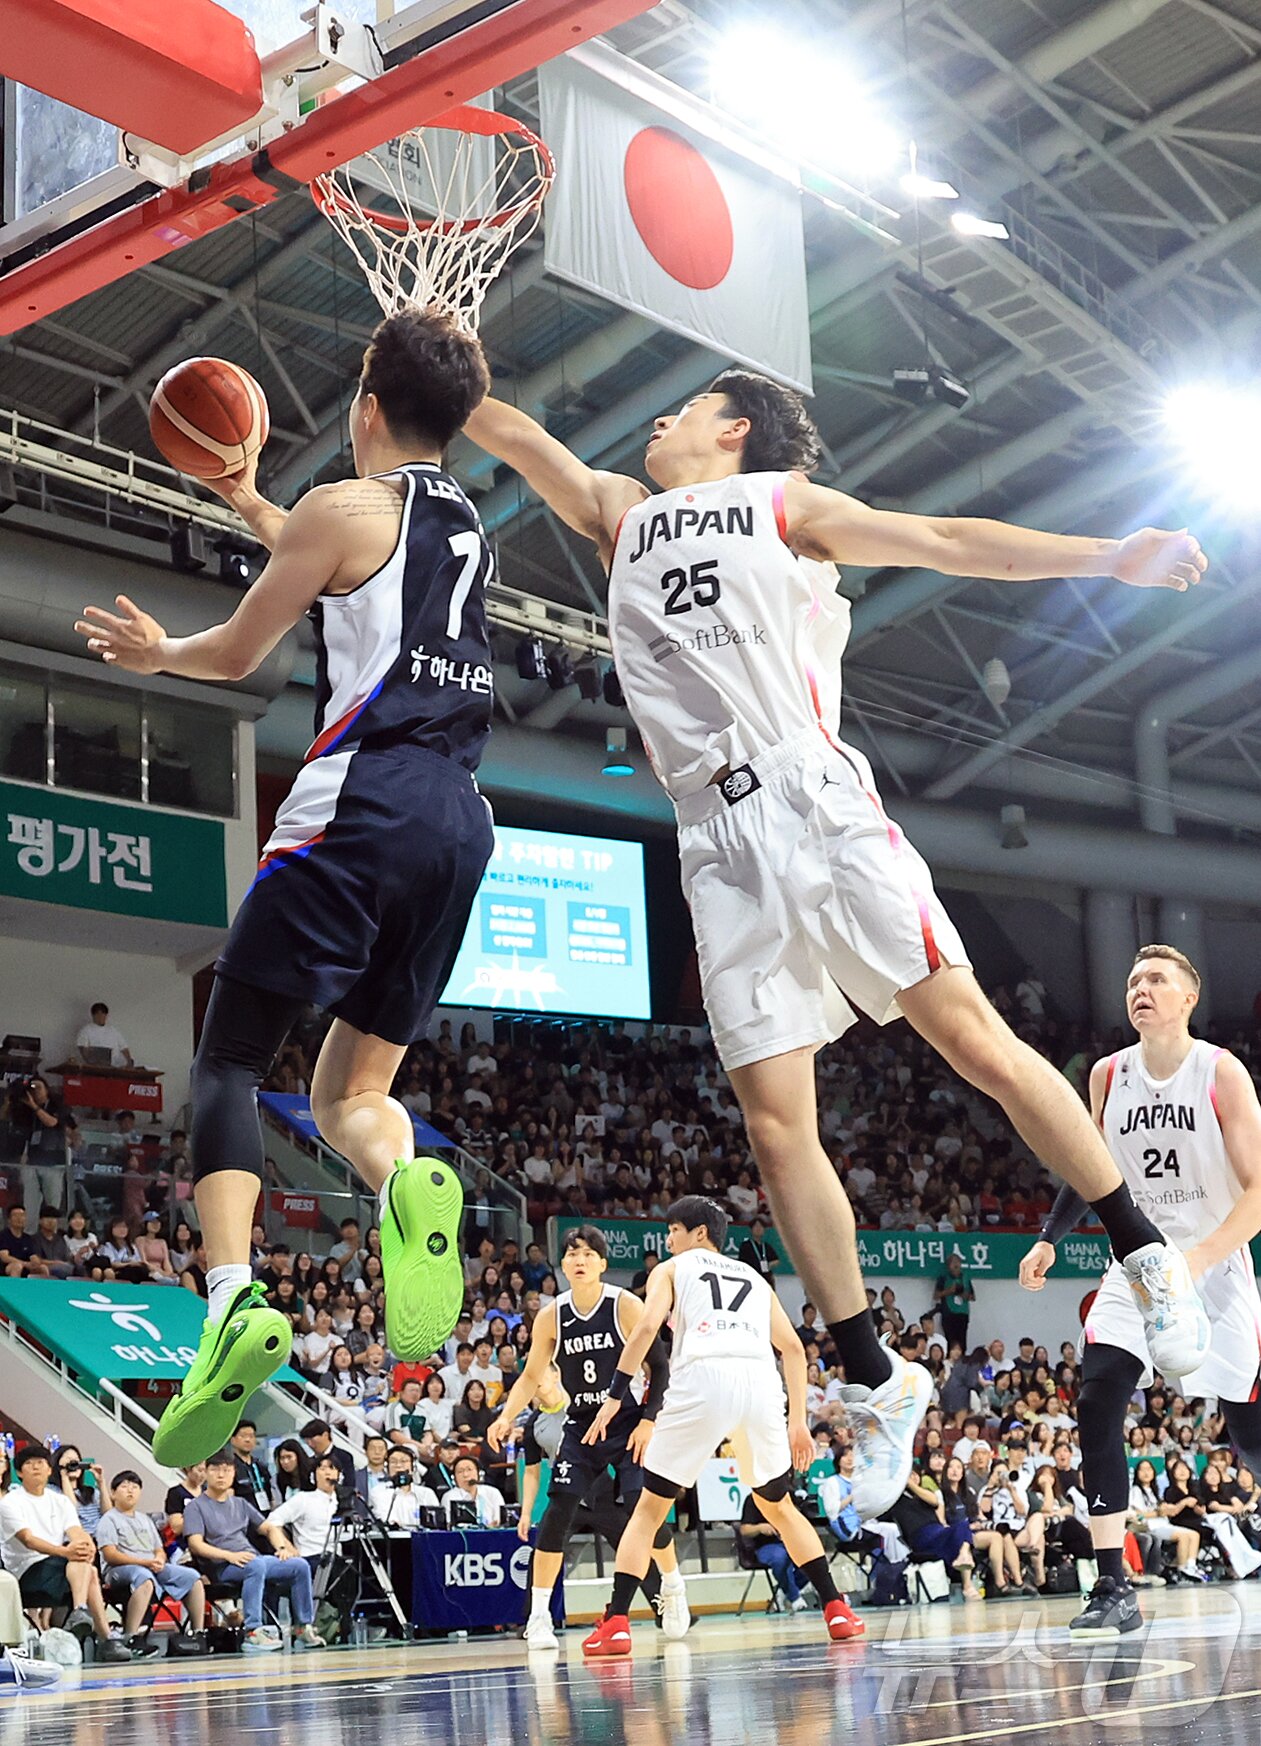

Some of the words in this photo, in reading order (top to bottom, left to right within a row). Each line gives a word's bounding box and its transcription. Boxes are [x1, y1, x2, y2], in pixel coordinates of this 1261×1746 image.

[629, 506, 754, 564] JAPAN
[446, 529, 482, 641] 7
[660, 559, 721, 616] 25
[664, 624, 767, 654] SoftBank
[429, 655, 493, 694] 하나은
[6, 812, 153, 893] 평가전
[128, 1083, 159, 1097] PRESS
[1119, 1103, 1196, 1136] JAPAN
[1143, 1148, 1180, 1178] 24
[283, 1197, 316, 1212] PRESS
[603, 1230, 629, 1244] ANA
[606, 1244, 640, 1259] NEXT
[1064, 1242, 1102, 1256] HANA
[698, 1271, 753, 1313] 17
[563, 1332, 615, 1356] KOREA
[583, 1359, 598, 1384] 8
[444, 1552, 505, 1587] KBS
